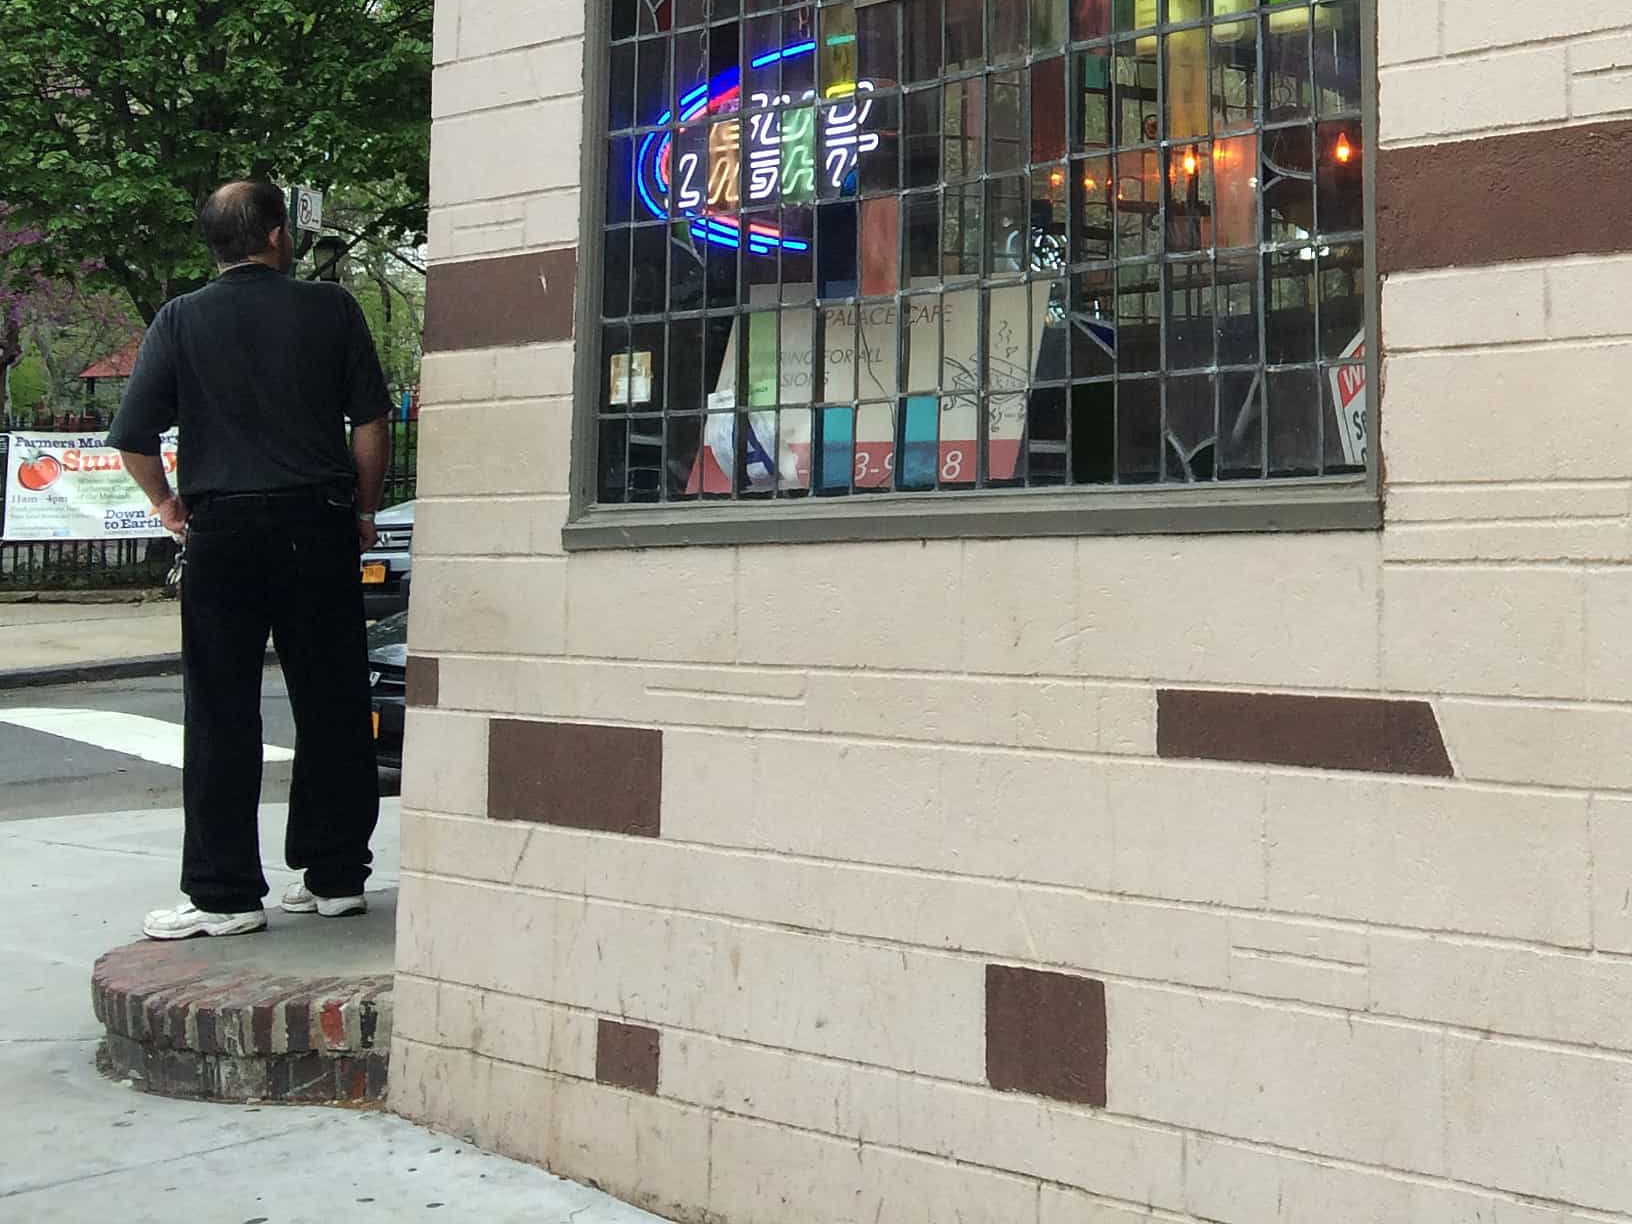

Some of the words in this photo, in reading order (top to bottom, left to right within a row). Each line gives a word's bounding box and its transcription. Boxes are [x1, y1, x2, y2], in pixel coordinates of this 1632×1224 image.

[15, 436, 76, 449] Farmers
[731, 412, 780, 485] A
[104, 509, 146, 519] Down
[104, 520, 120, 530] to
